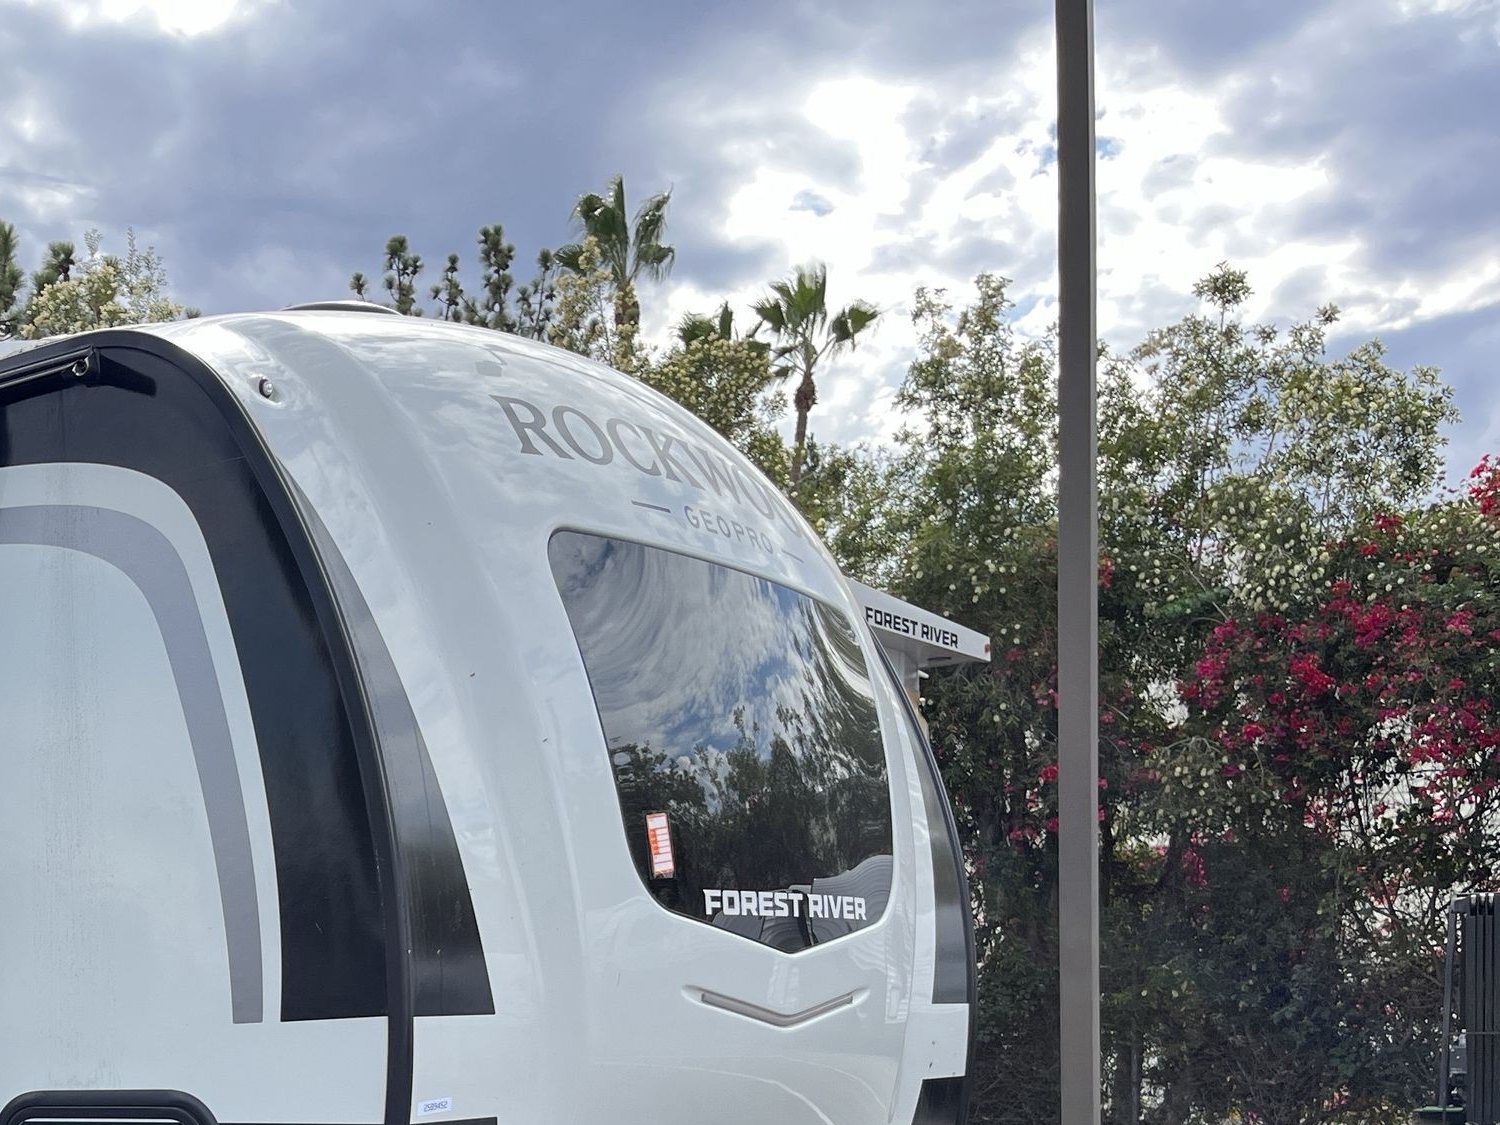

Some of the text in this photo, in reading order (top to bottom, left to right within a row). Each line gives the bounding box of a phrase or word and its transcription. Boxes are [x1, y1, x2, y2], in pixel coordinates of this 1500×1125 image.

[683, 505, 774, 554] GEOPRO
[864, 606, 959, 649] FOREST RIVER
[702, 889, 867, 920] FOREST RIVER
